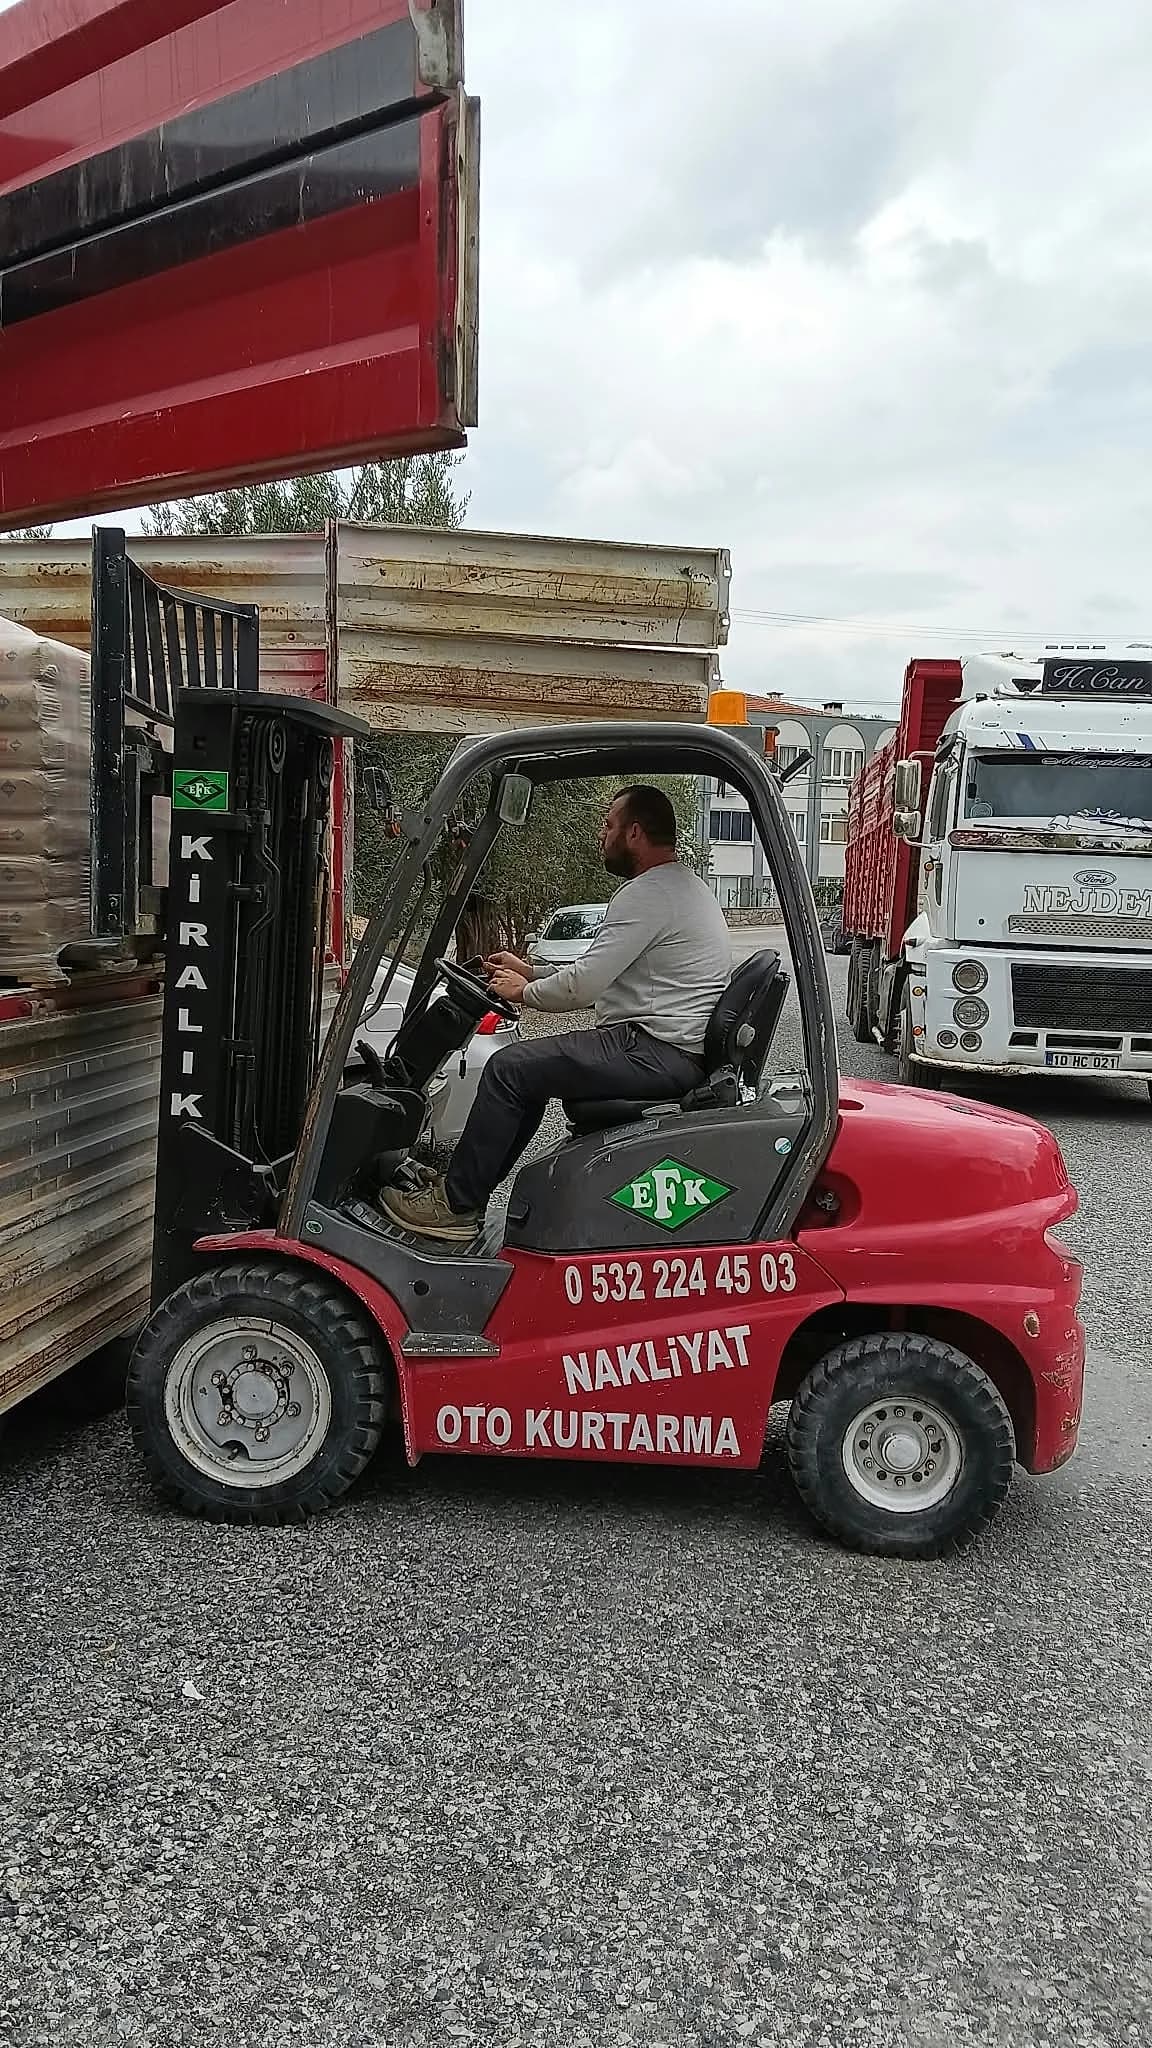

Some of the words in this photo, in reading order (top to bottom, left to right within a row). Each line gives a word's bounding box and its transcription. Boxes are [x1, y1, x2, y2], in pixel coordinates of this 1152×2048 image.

[189, 782, 212, 798] EFK
[1055, 1055, 1068, 1066] 10
[1073, 1055, 1088, 1067] HC
[1093, 1056, 1116, 1069] 021
[630, 1168, 711, 1220] EFK
[564, 1265, 583, 1305] 0
[591, 1261, 646, 1303] 532
[652, 1257, 707, 1299] 224
[715, 1254, 751, 1294] 45
[760, 1252, 797, 1293] 03
[436, 1405, 512, 1446] OTO
[525, 1408, 741, 1457] KURTARMA
